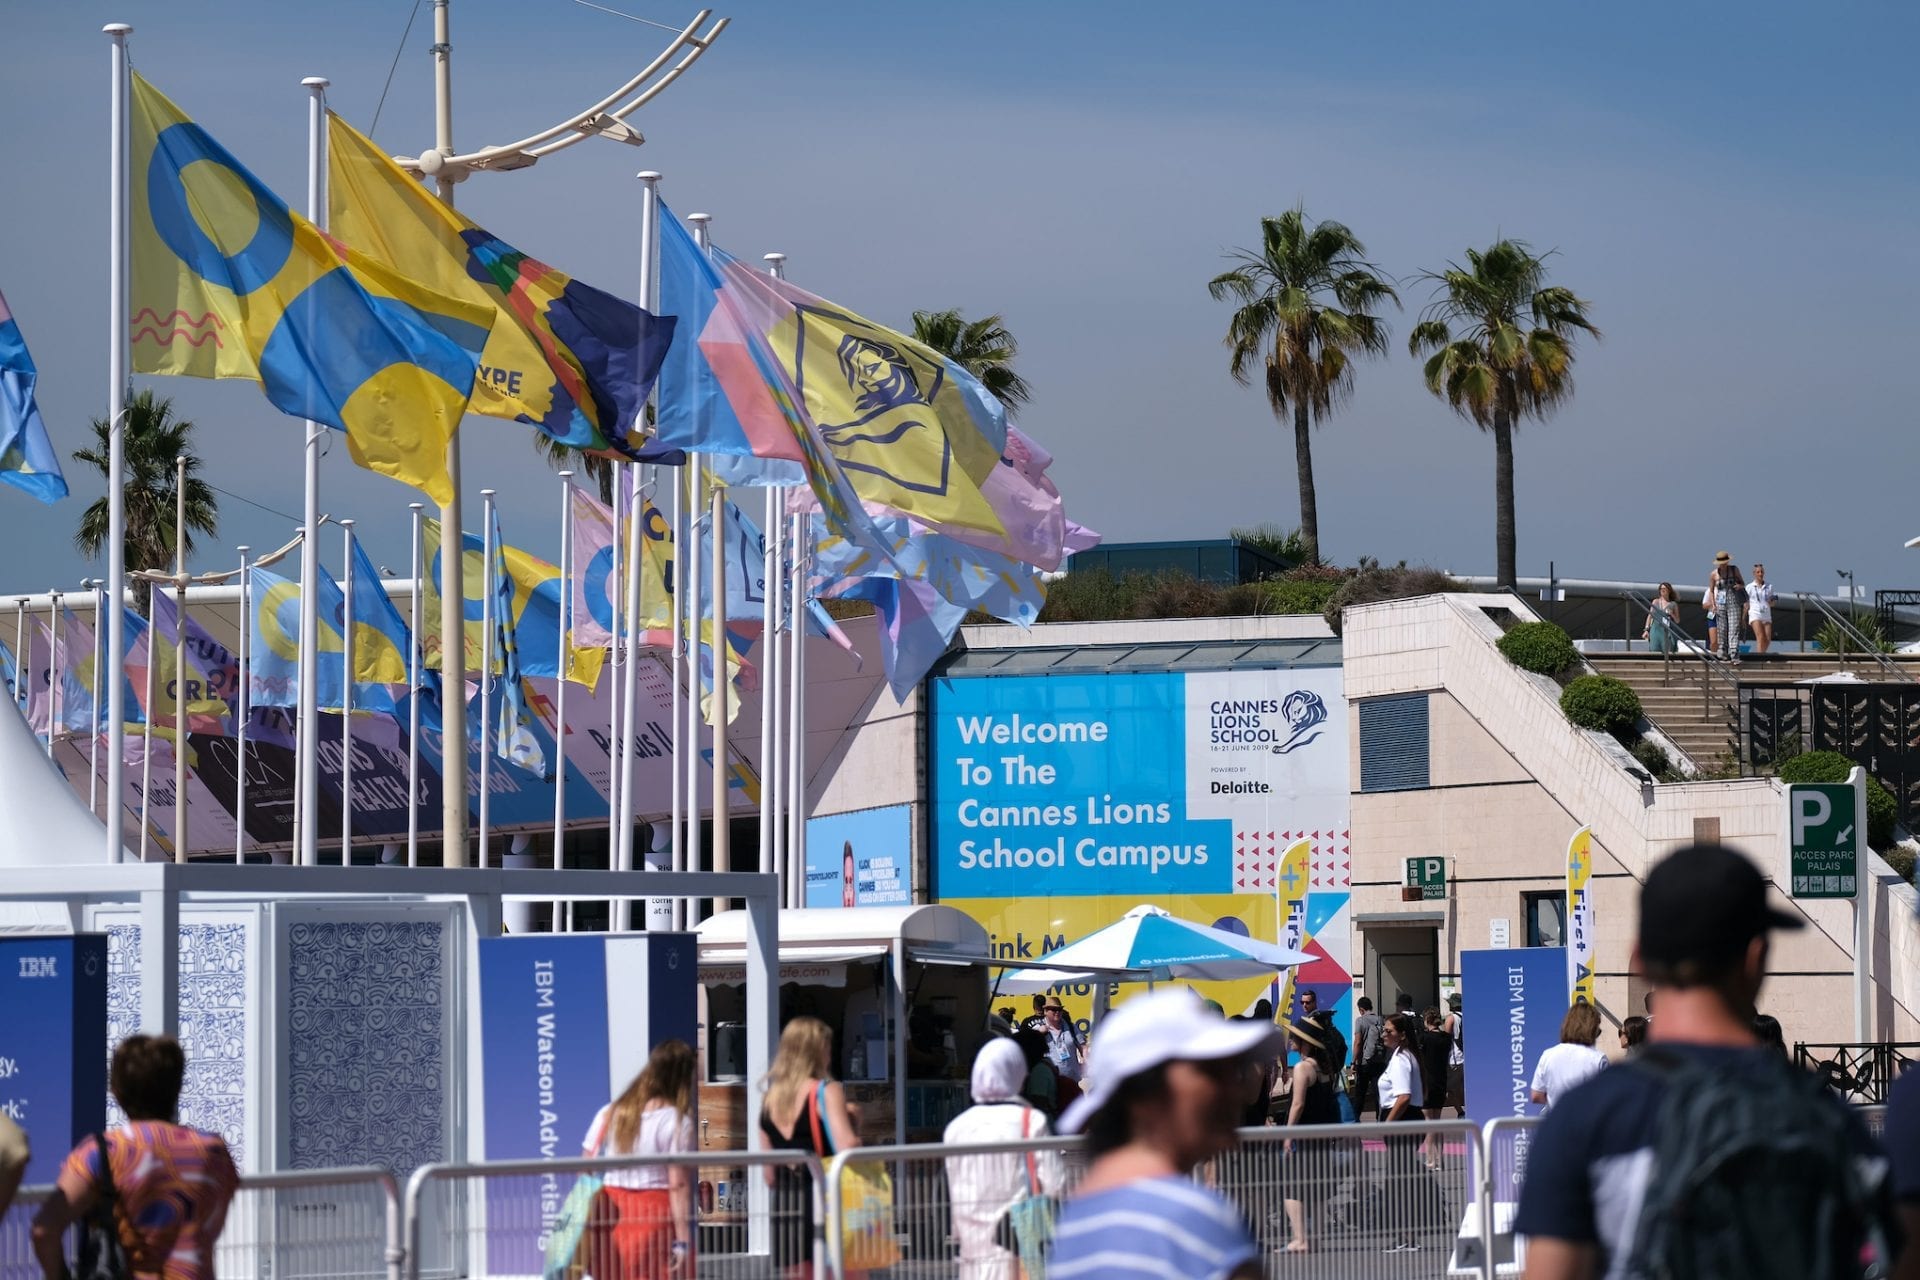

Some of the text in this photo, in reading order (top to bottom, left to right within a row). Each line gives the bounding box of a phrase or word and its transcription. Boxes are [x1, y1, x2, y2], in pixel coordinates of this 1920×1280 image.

[1210, 700, 1278, 714] CANNES
[1210, 715, 1261, 729] LIONS
[956, 713, 1109, 745] Welcome
[1210, 729, 1279, 743] SCHOOL
[1252, 744, 1270, 752] 2019
[956, 754, 1057, 786] To The
[957, 794, 1171, 828] Cannes Lions
[1791, 790, 1832, 847] P
[958, 836, 1209, 875] School Campus
[1424, 859, 1441, 882] P
[1793, 850, 1855, 860] ACCES PARC
[1807, 861, 1841, 871] PALAIS
[1287, 899, 1304, 950] Firs
[19, 957, 57, 977] IBM
[534, 960, 554, 1007] IBM
[1508, 966, 1524, 1002] IBM
[1510, 1005, 1526, 1076] Watson
[536, 1013, 557, 1105] Watson
